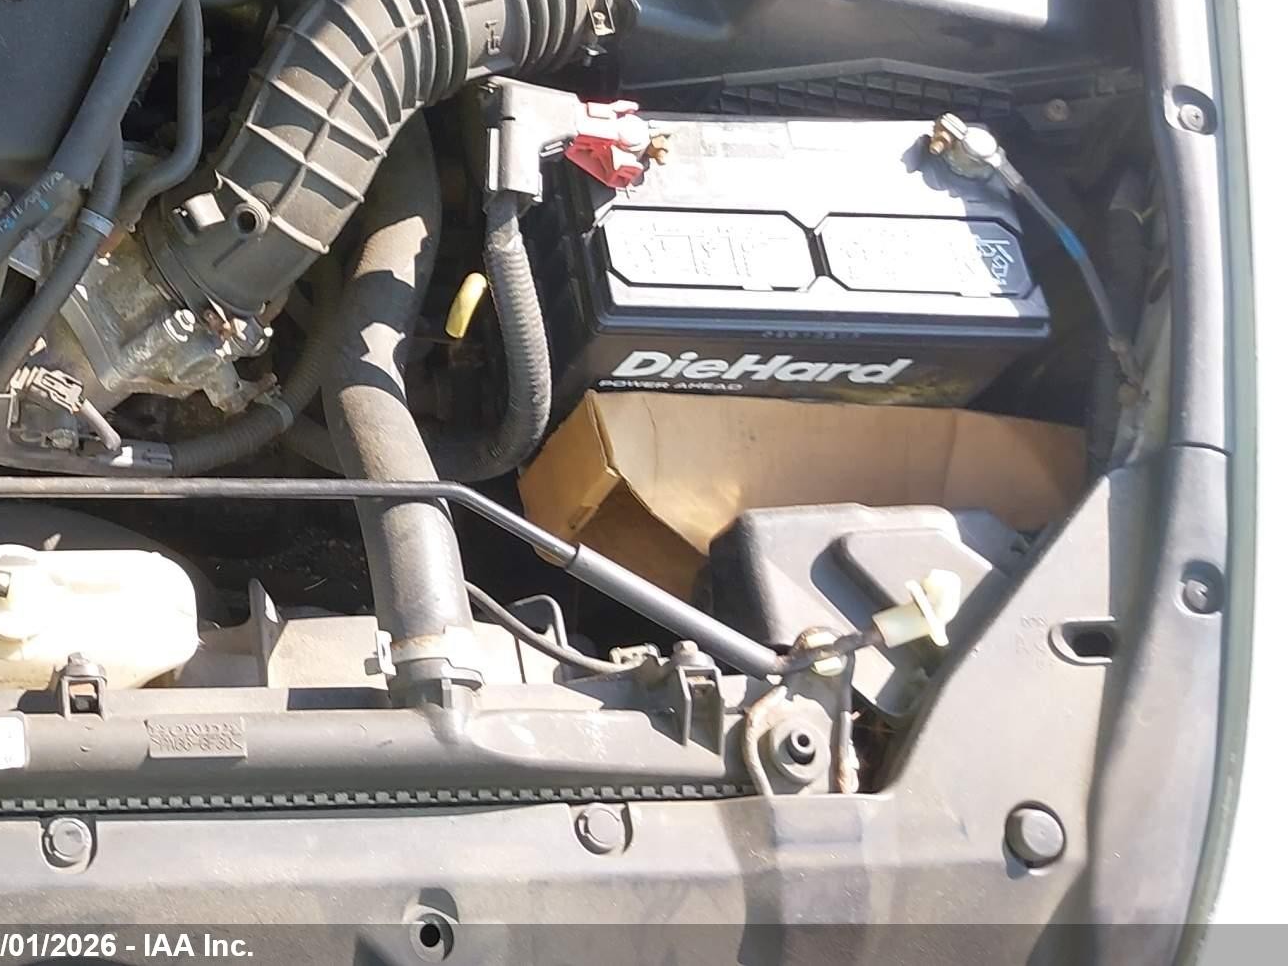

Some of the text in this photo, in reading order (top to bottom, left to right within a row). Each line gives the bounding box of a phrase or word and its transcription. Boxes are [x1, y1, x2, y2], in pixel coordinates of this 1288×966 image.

[612, 350, 913, 384] DieHard
[598, 378, 743, 391] POWER AHEAD
